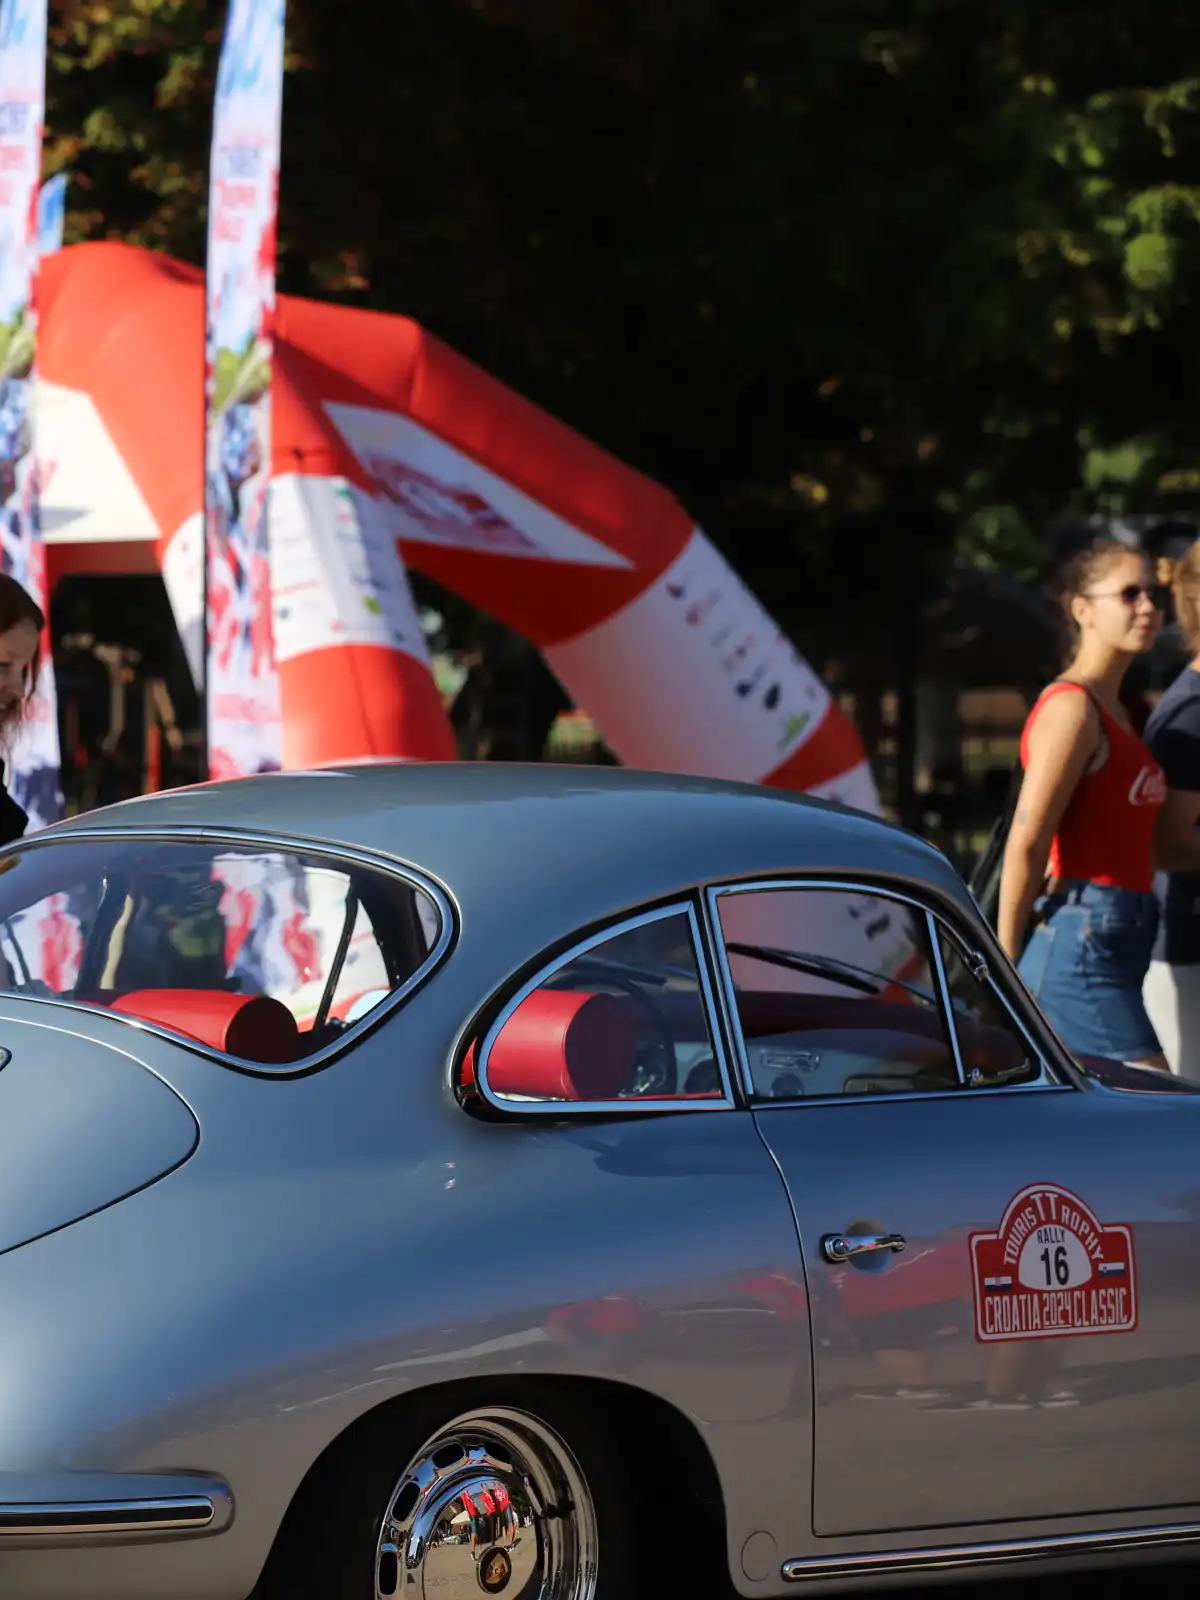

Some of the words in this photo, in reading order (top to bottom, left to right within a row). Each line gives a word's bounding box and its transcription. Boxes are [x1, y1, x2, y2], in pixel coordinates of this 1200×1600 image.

[1003, 1192, 1046, 1265] TOURIST
[1044, 1193, 1104, 1260] TROPHY
[1037, 1227, 1066, 1244] RALLY
[1040, 1246, 1069, 1286] 16
[985, 1293, 1041, 1333] CROATIA
[1043, 1291, 1072, 1326] 2024
[1073, 1287, 1128, 1326] CLASSIC
